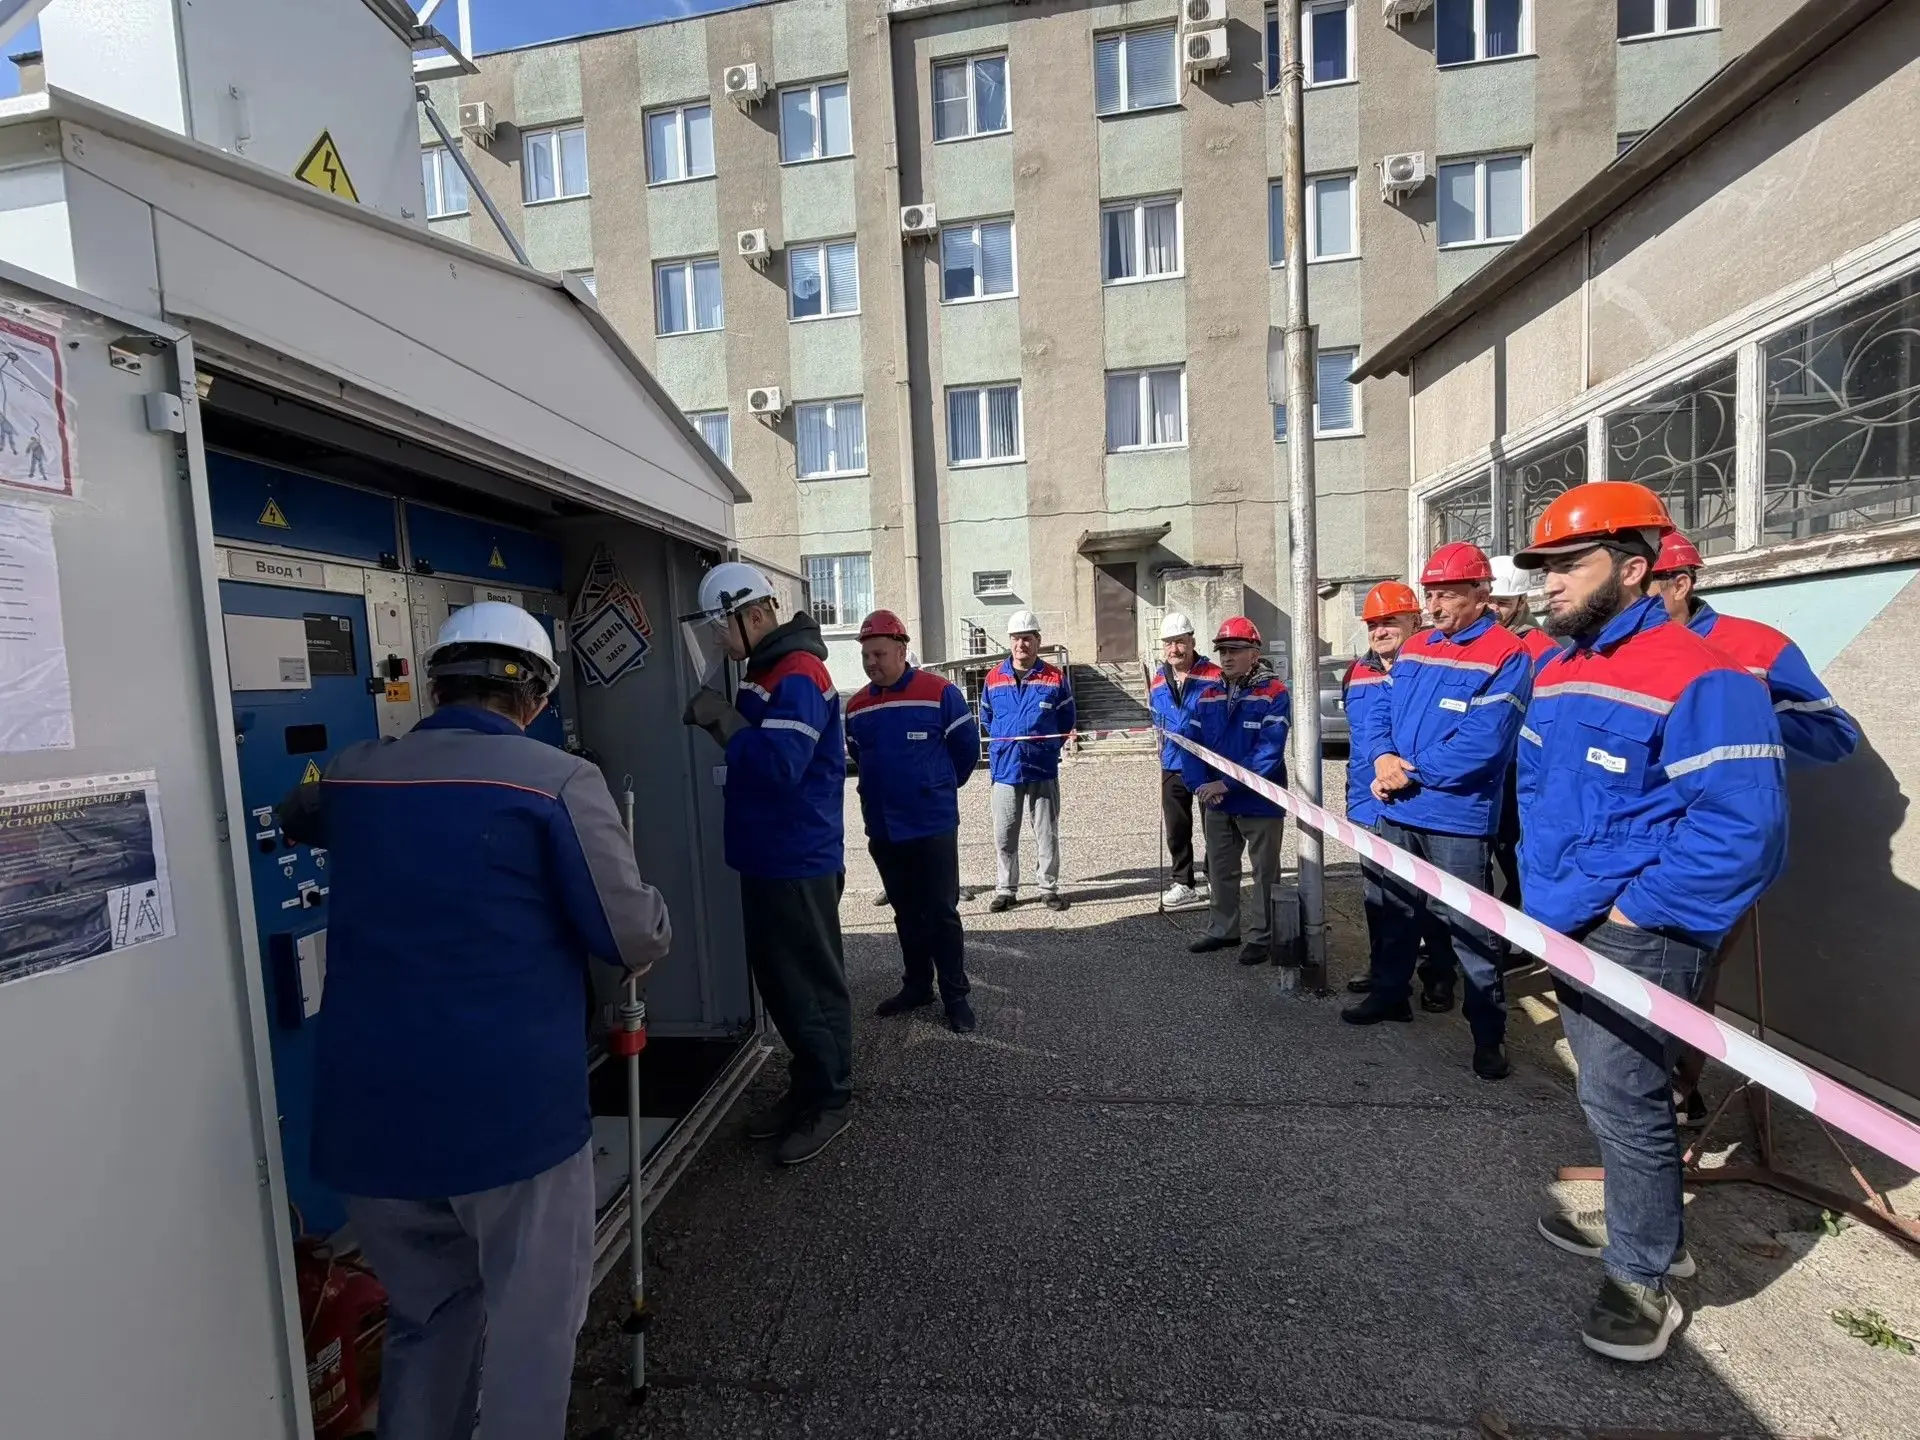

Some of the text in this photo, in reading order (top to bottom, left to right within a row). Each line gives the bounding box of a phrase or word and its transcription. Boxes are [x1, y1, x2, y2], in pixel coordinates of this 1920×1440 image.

[256, 561, 303, 578] Ввод 1
[586, 621, 624, 656] ВЛЕЗАТЬ
[605, 643, 627, 663] ЗДЕСЬ
